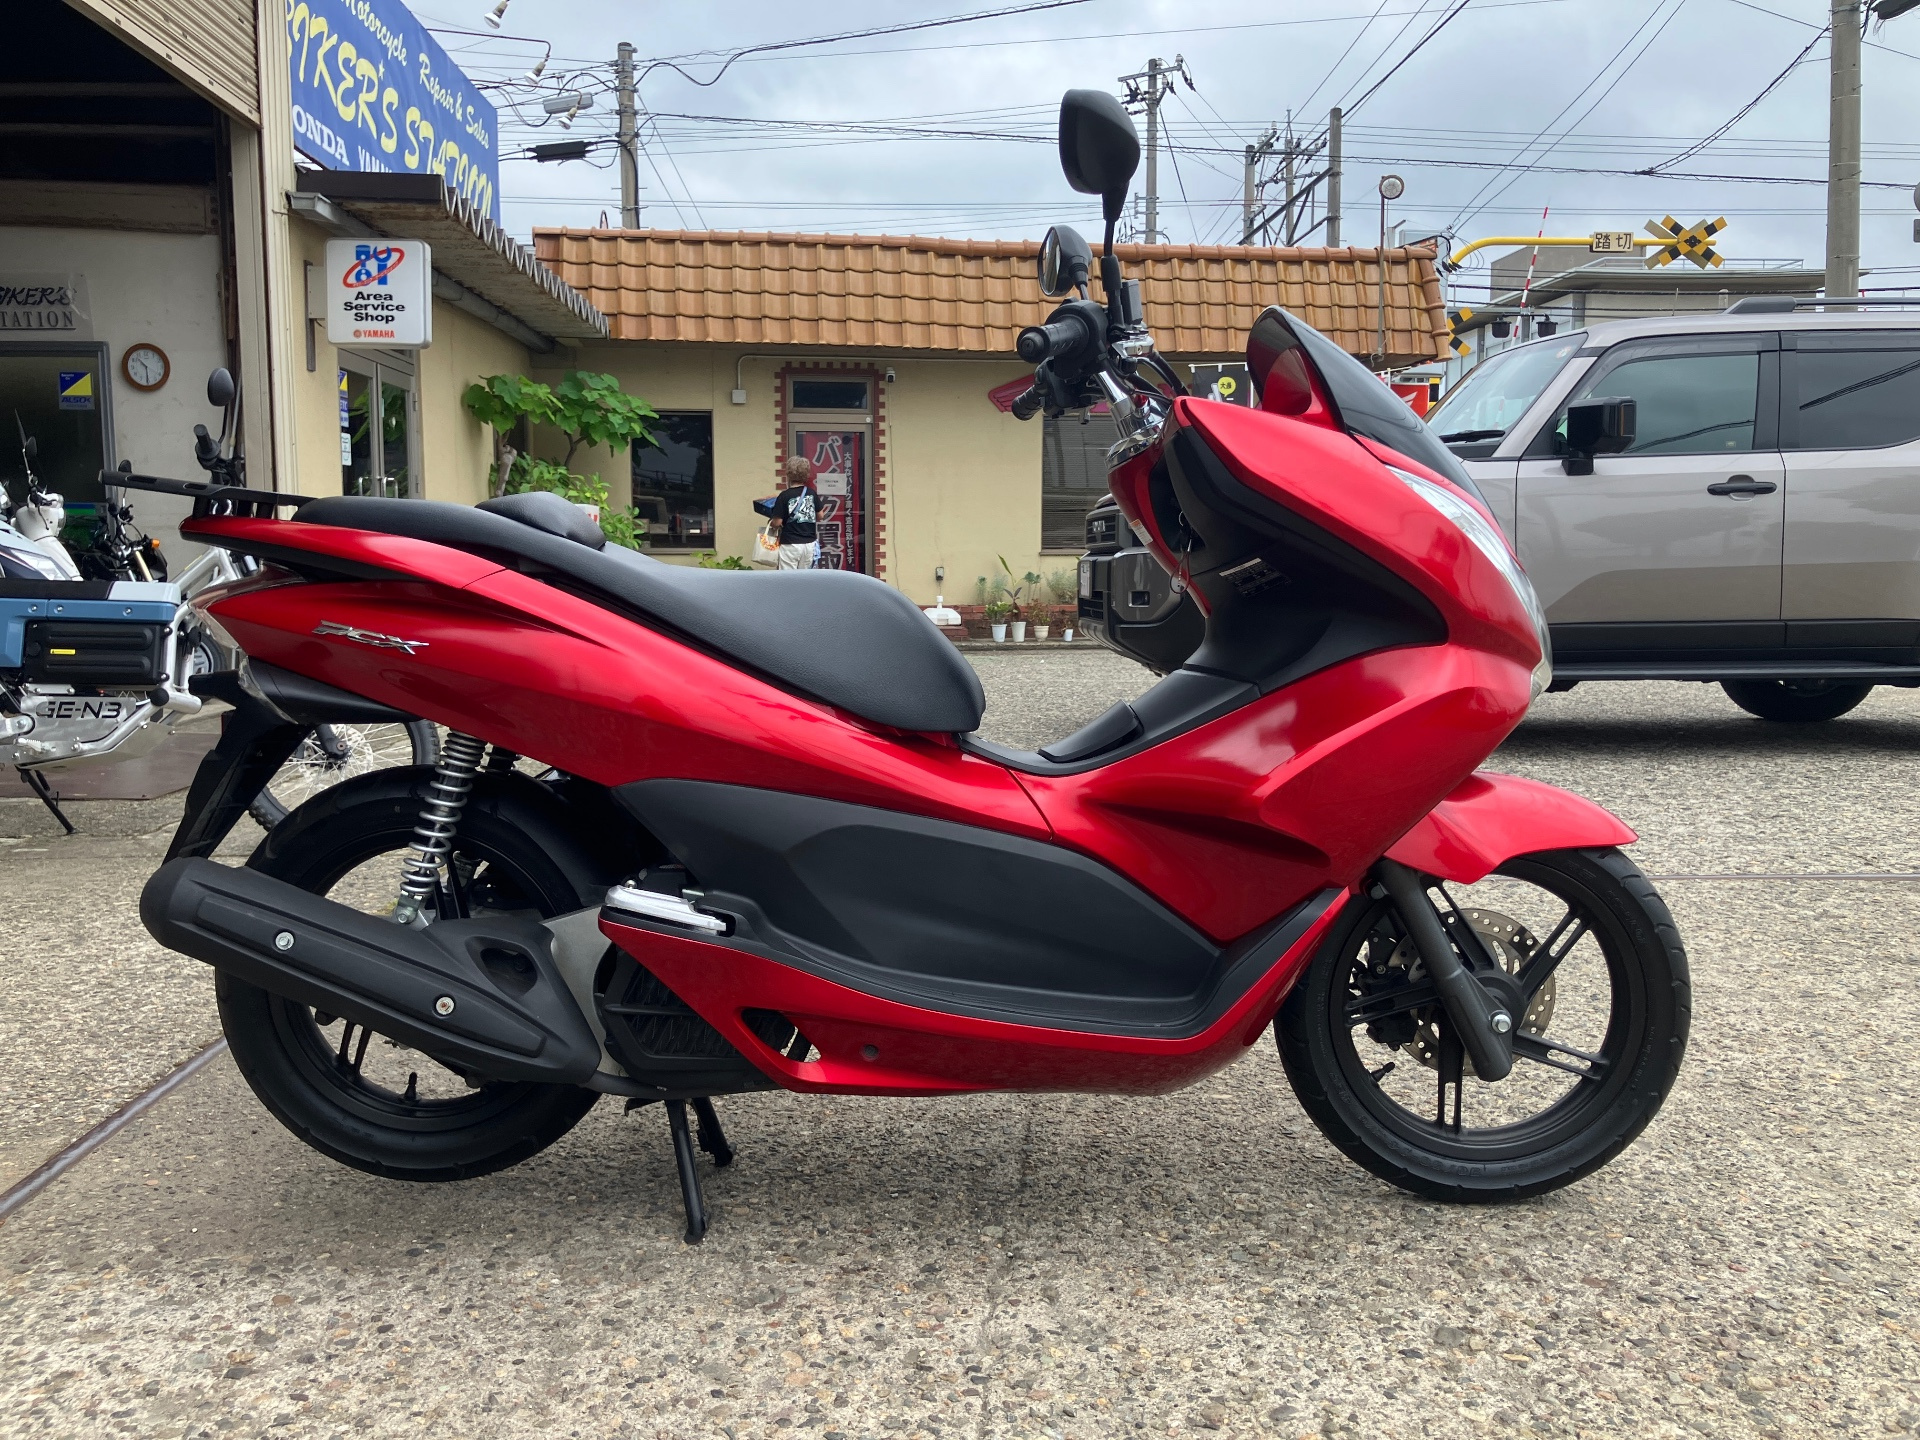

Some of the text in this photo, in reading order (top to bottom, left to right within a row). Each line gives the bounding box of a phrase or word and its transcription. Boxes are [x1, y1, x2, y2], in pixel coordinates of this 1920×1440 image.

[419, 53, 454, 114] Repair
[455, 92, 463, 122] &
[466, 105, 489, 149] Sales
[292, 105, 349, 166] ONDA
[1594, 233, 1632, 250] 踏切
[354, 291, 393, 301] Area
[343, 302, 405, 311] Service
[0, 311, 73, 327] TATION
[354, 312, 395, 324] Shop
[363, 330, 395, 338] YAMAHA
[812, 436, 844, 569] バク買取
